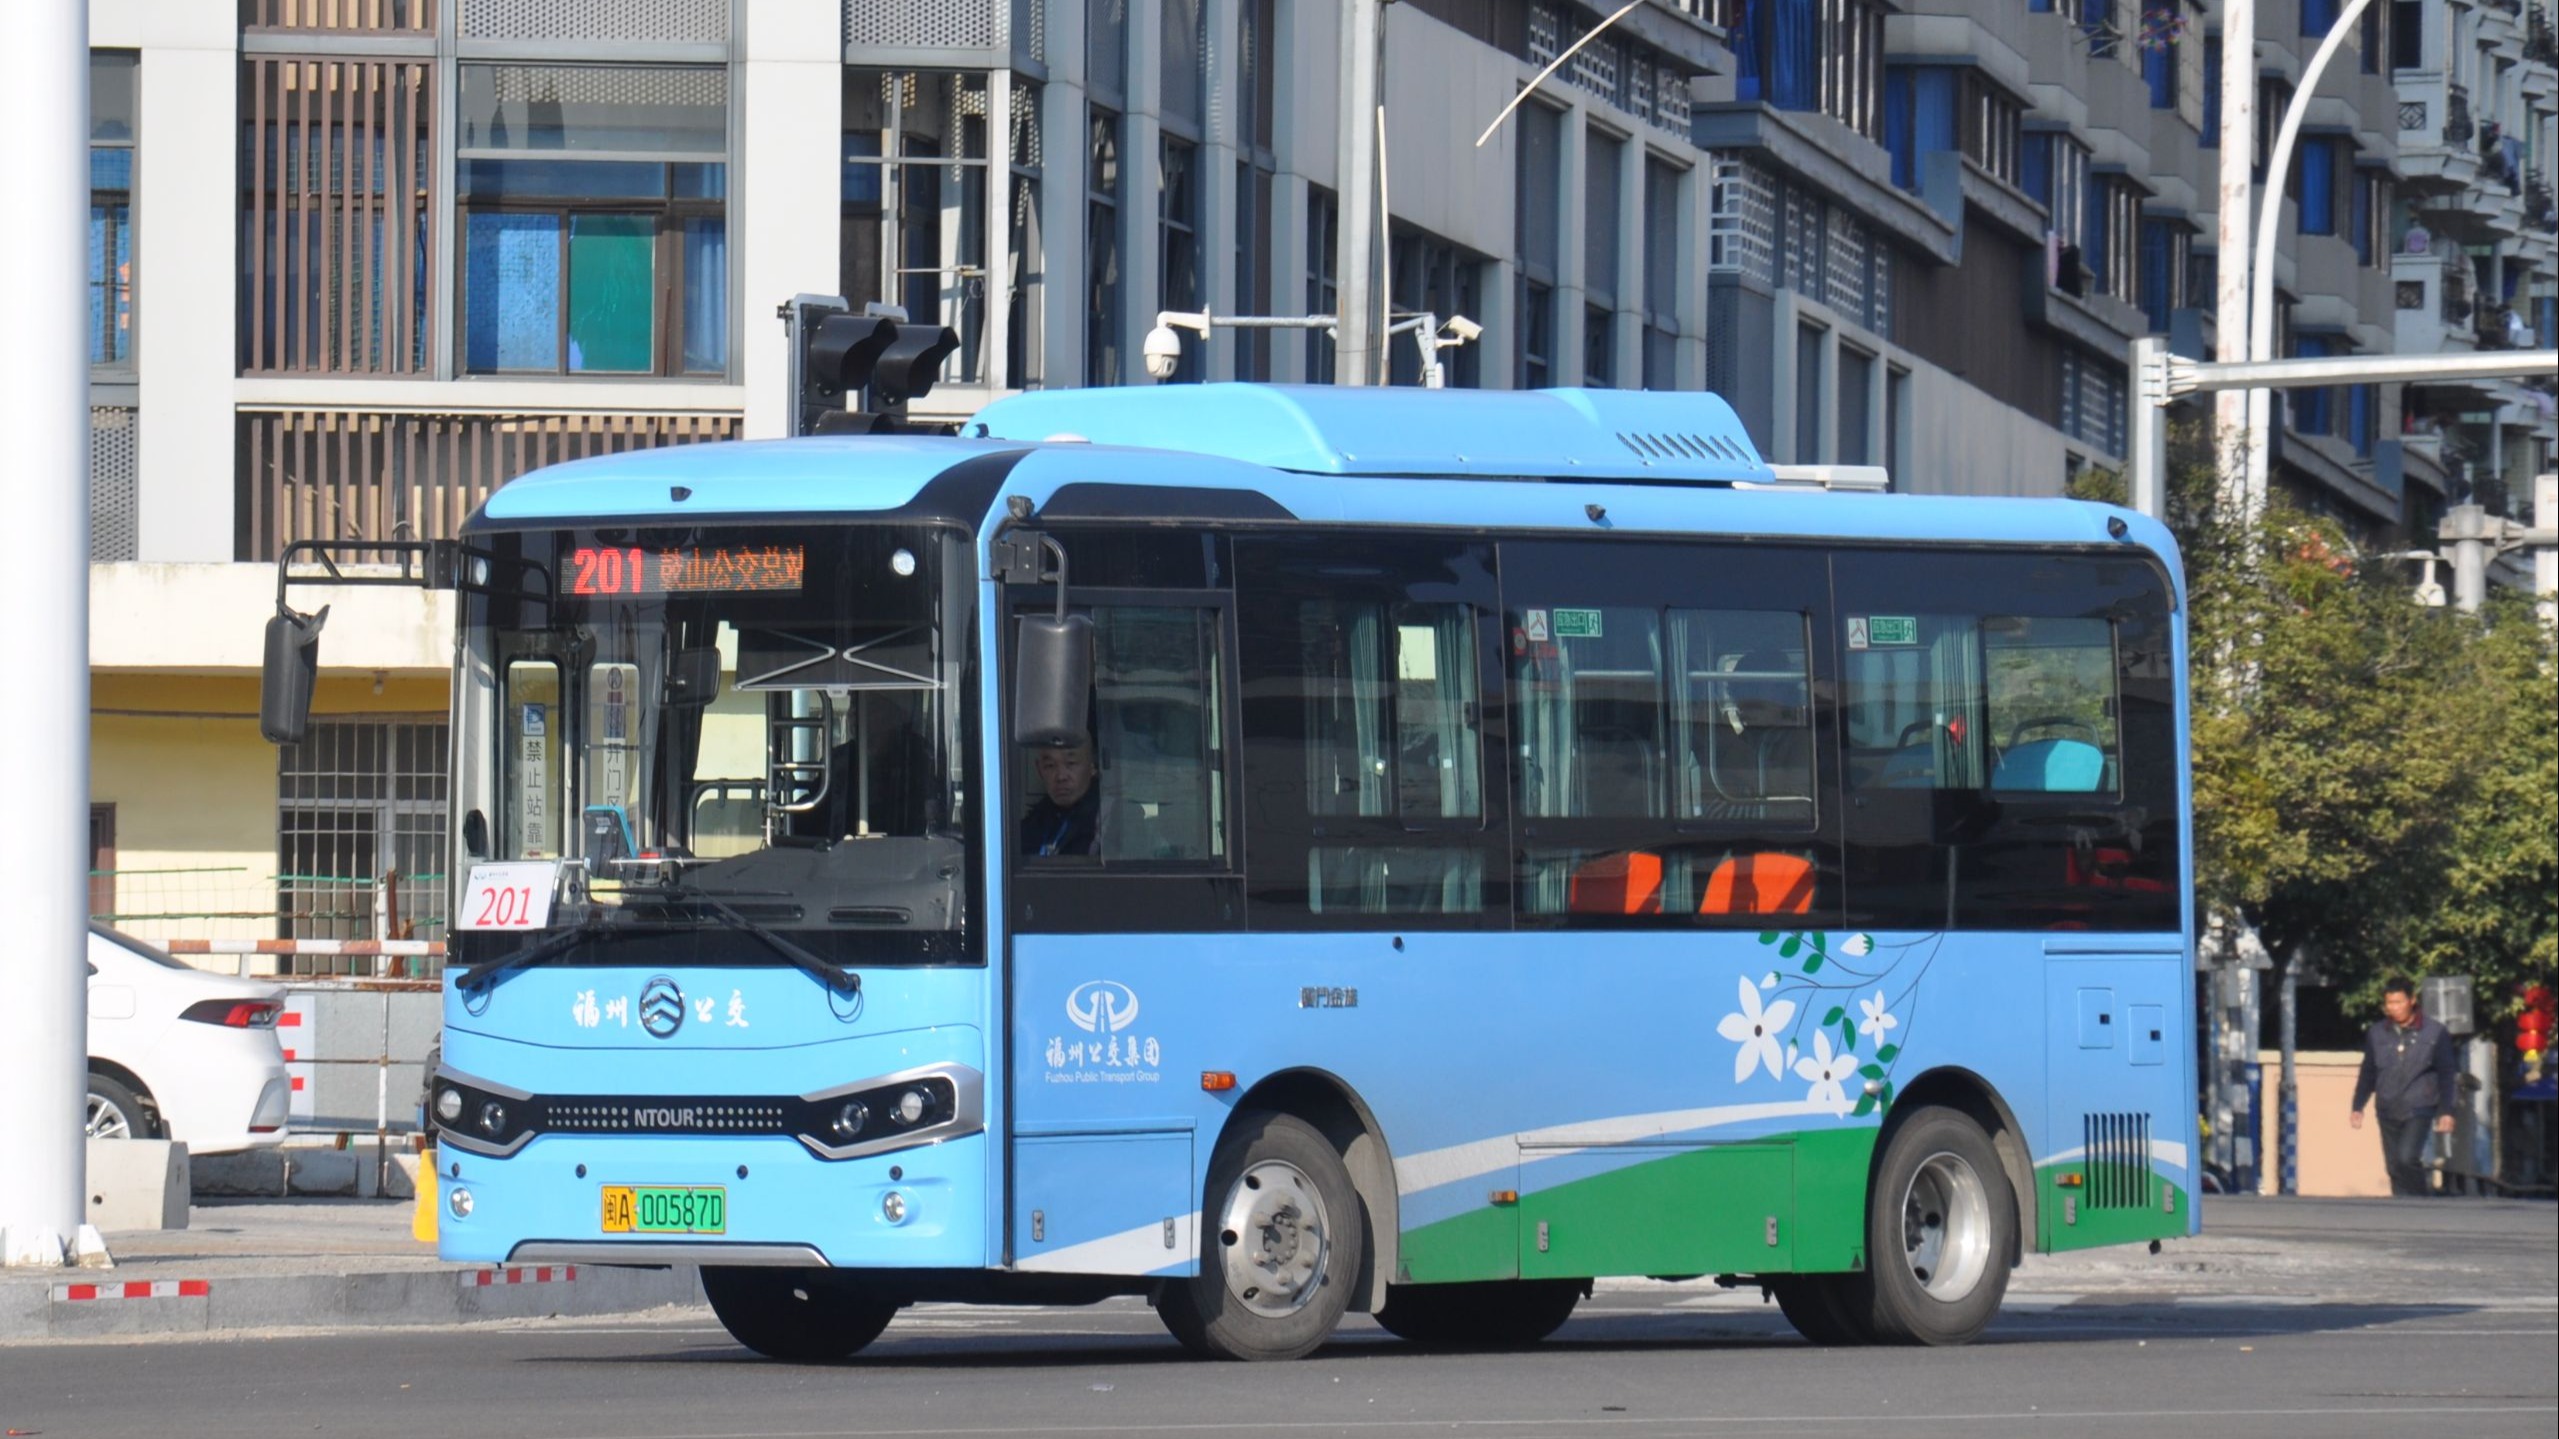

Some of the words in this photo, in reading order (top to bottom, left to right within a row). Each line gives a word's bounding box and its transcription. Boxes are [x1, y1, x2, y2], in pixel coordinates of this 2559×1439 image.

[574, 548, 643, 593] 201
[526, 740, 543, 844] 禁止站靠
[475, 887, 530, 925] 201
[1045, 1071, 1074, 1083] Fuzhou
[1075, 1071, 1098, 1083] Public
[1100, 1071, 1135, 1085] Transport
[1136, 1070, 1160, 1084] Group
[634, 1108, 694, 1127] NTOUR
